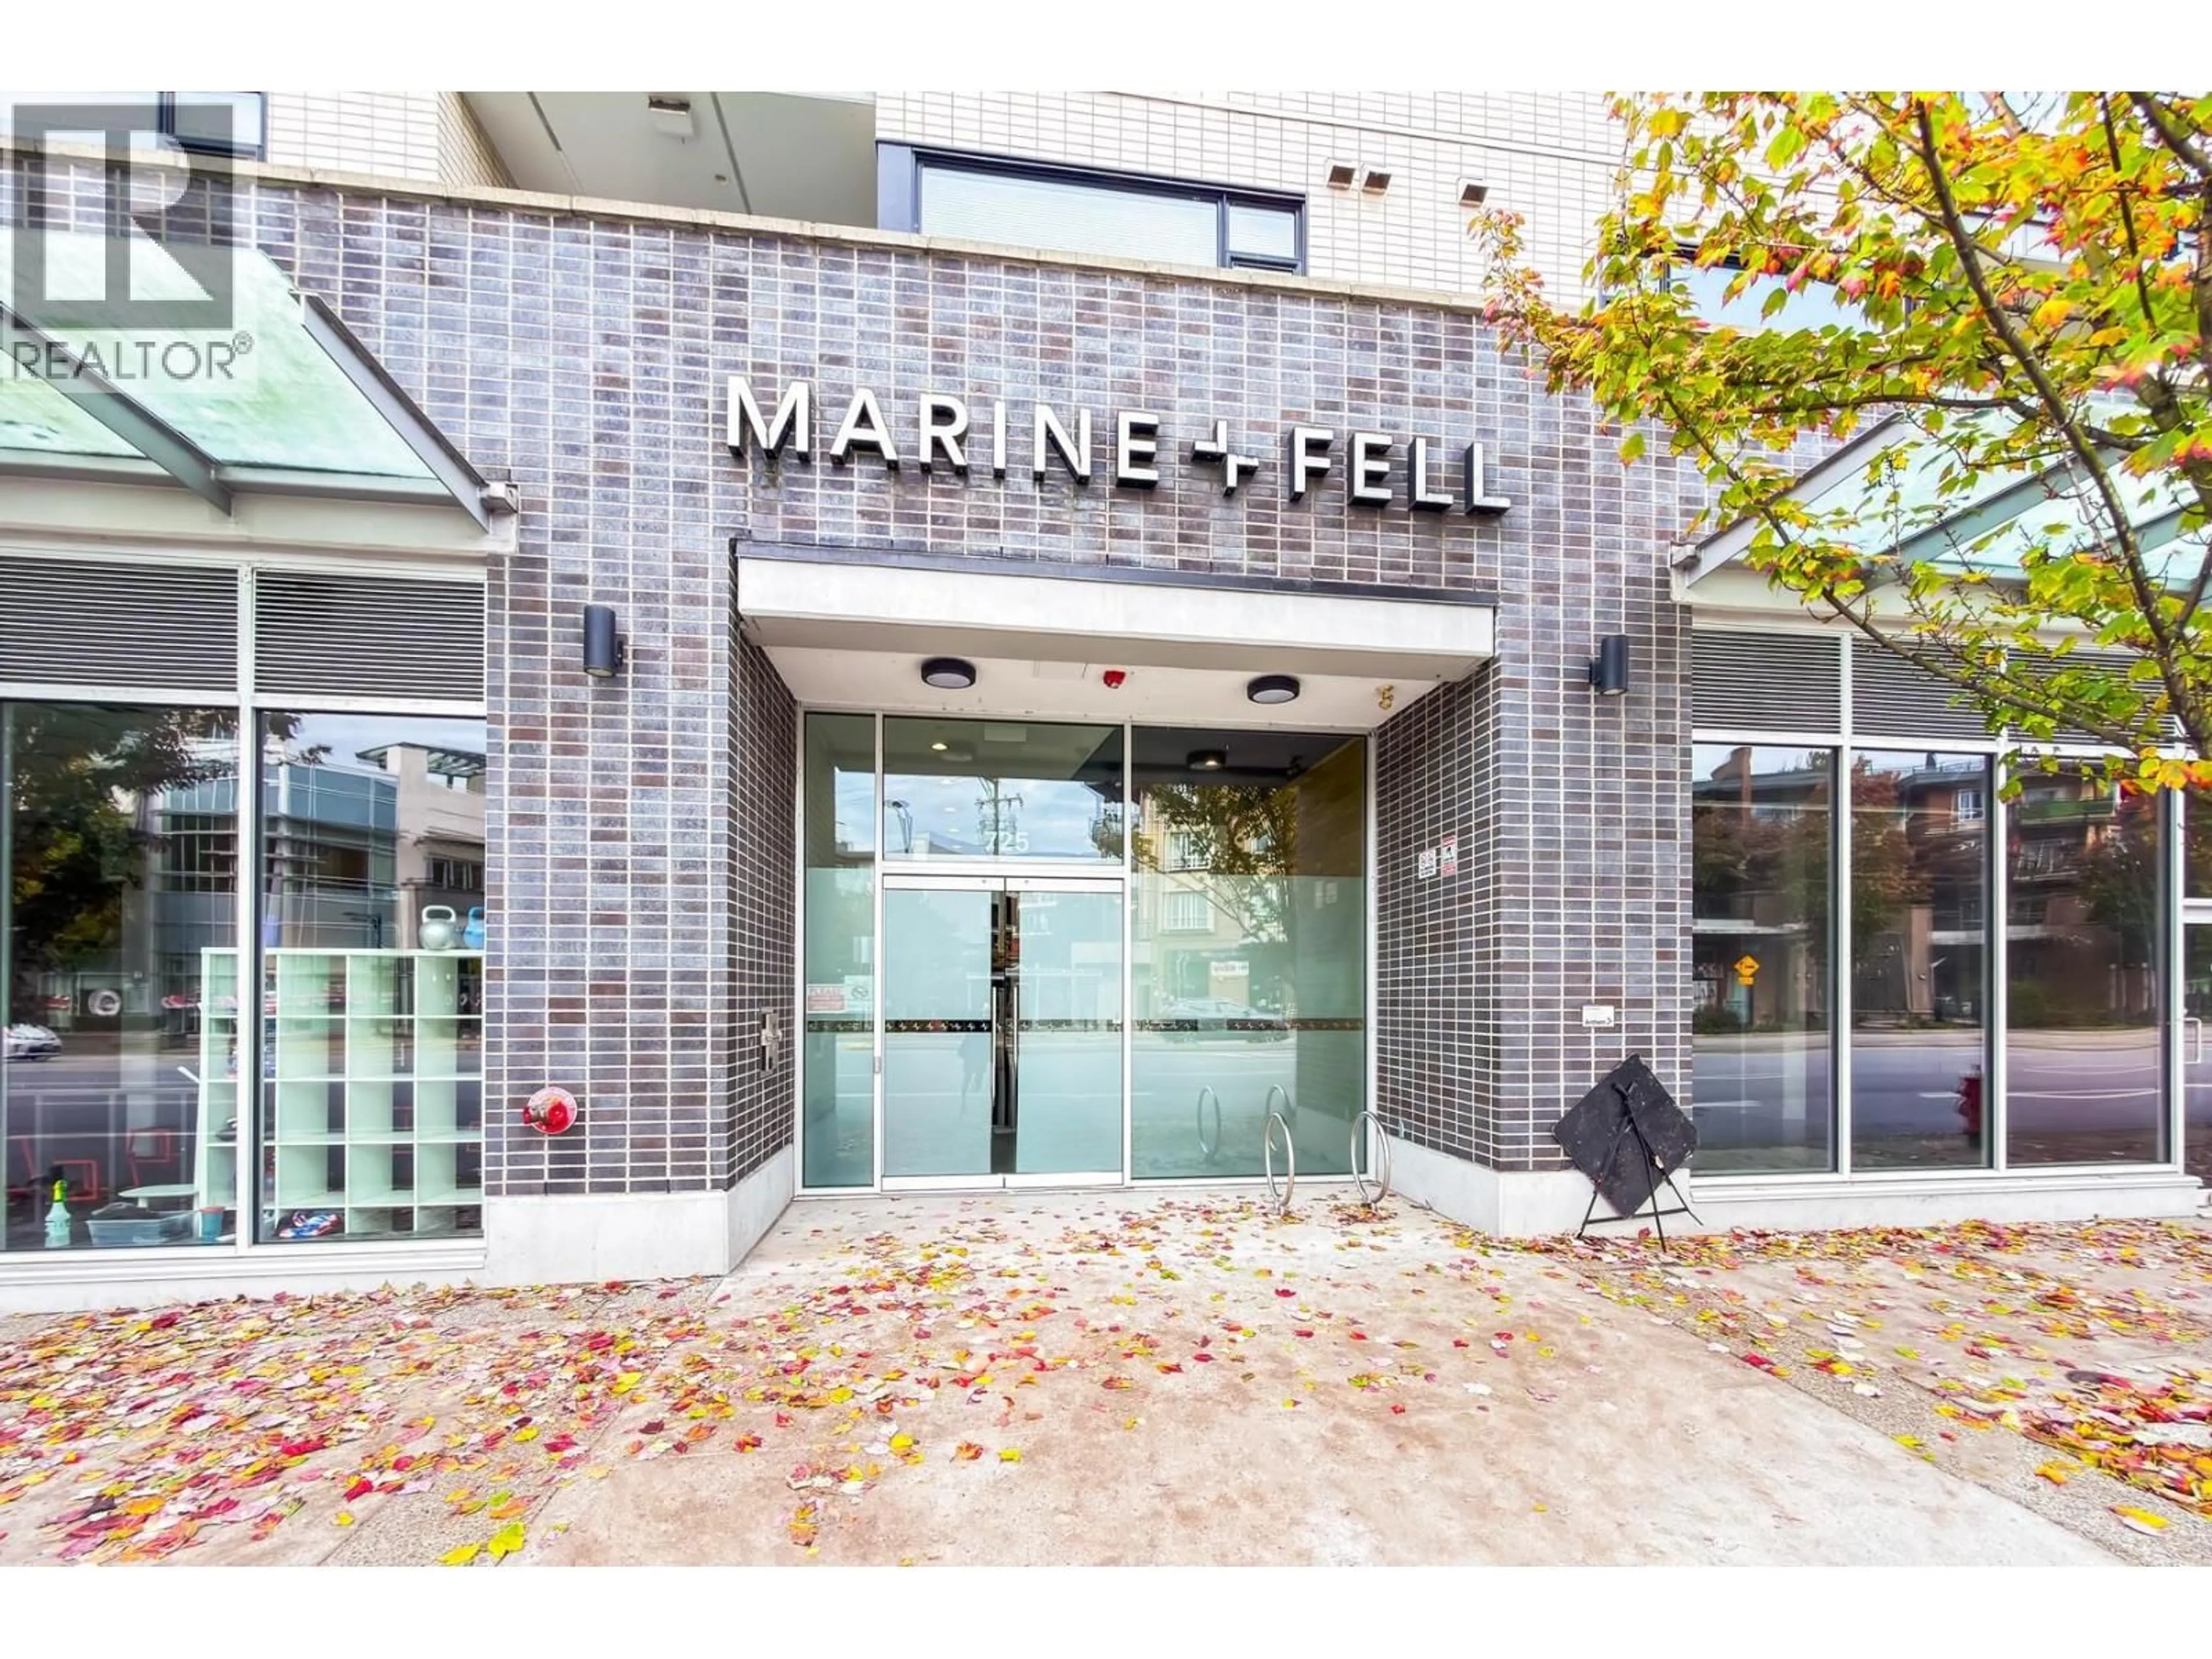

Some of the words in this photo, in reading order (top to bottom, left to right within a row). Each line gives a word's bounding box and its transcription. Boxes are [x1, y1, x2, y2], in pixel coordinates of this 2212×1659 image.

[727, 376, 1160, 487] MARINE
[1289, 426, 1511, 515] FELL
[984, 831, 1029, 853] 725
